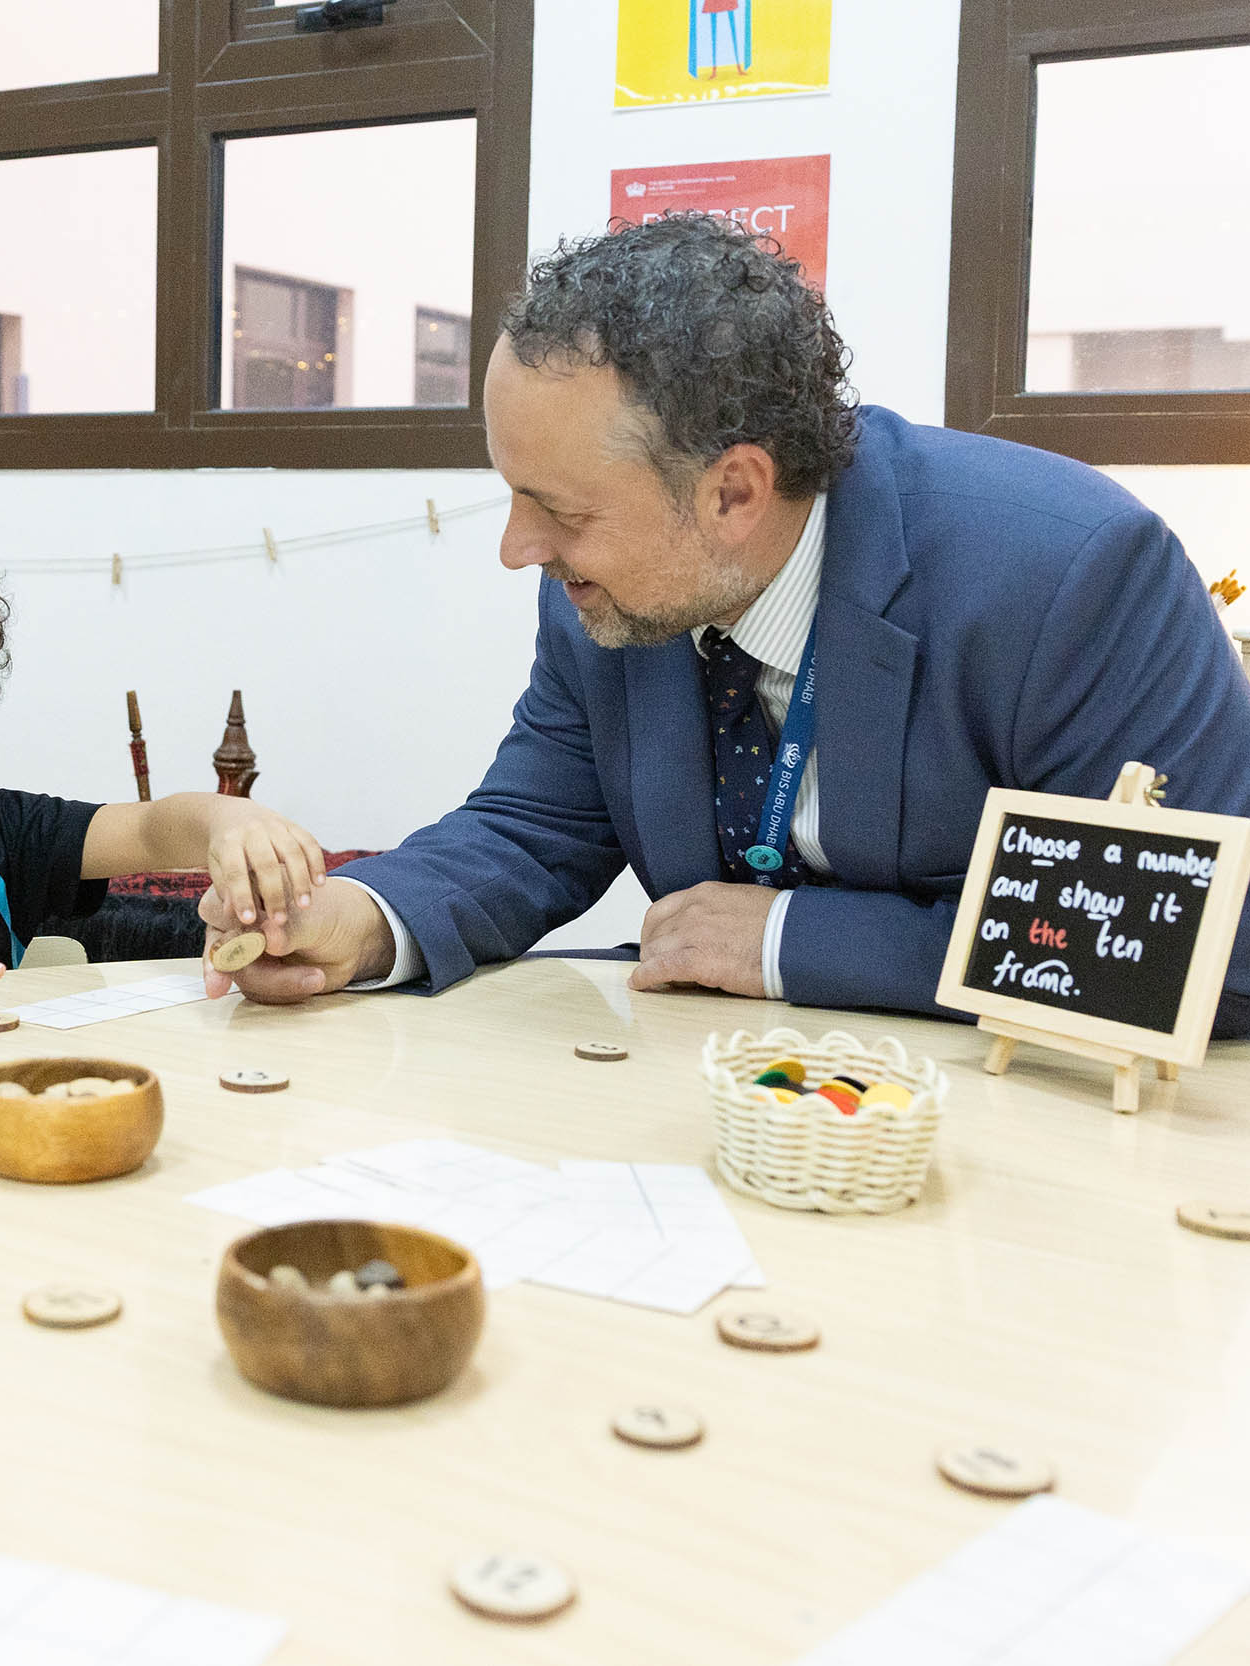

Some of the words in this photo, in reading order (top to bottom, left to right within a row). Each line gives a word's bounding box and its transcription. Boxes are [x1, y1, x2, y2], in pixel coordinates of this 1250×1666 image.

[778, 770, 792, 790] BIS
[772, 789, 787, 815] ABU
[766, 814, 781, 848] DHABI
[1103, 844, 1122, 864] a
[991, 876, 1038, 902] and
[1058, 880, 1125, 917] show
[1150, 892, 1182, 923] it
[981, 918, 1010, 941] on
[1029, 917, 1068, 949] the
[1096, 920, 1143, 962] ten
